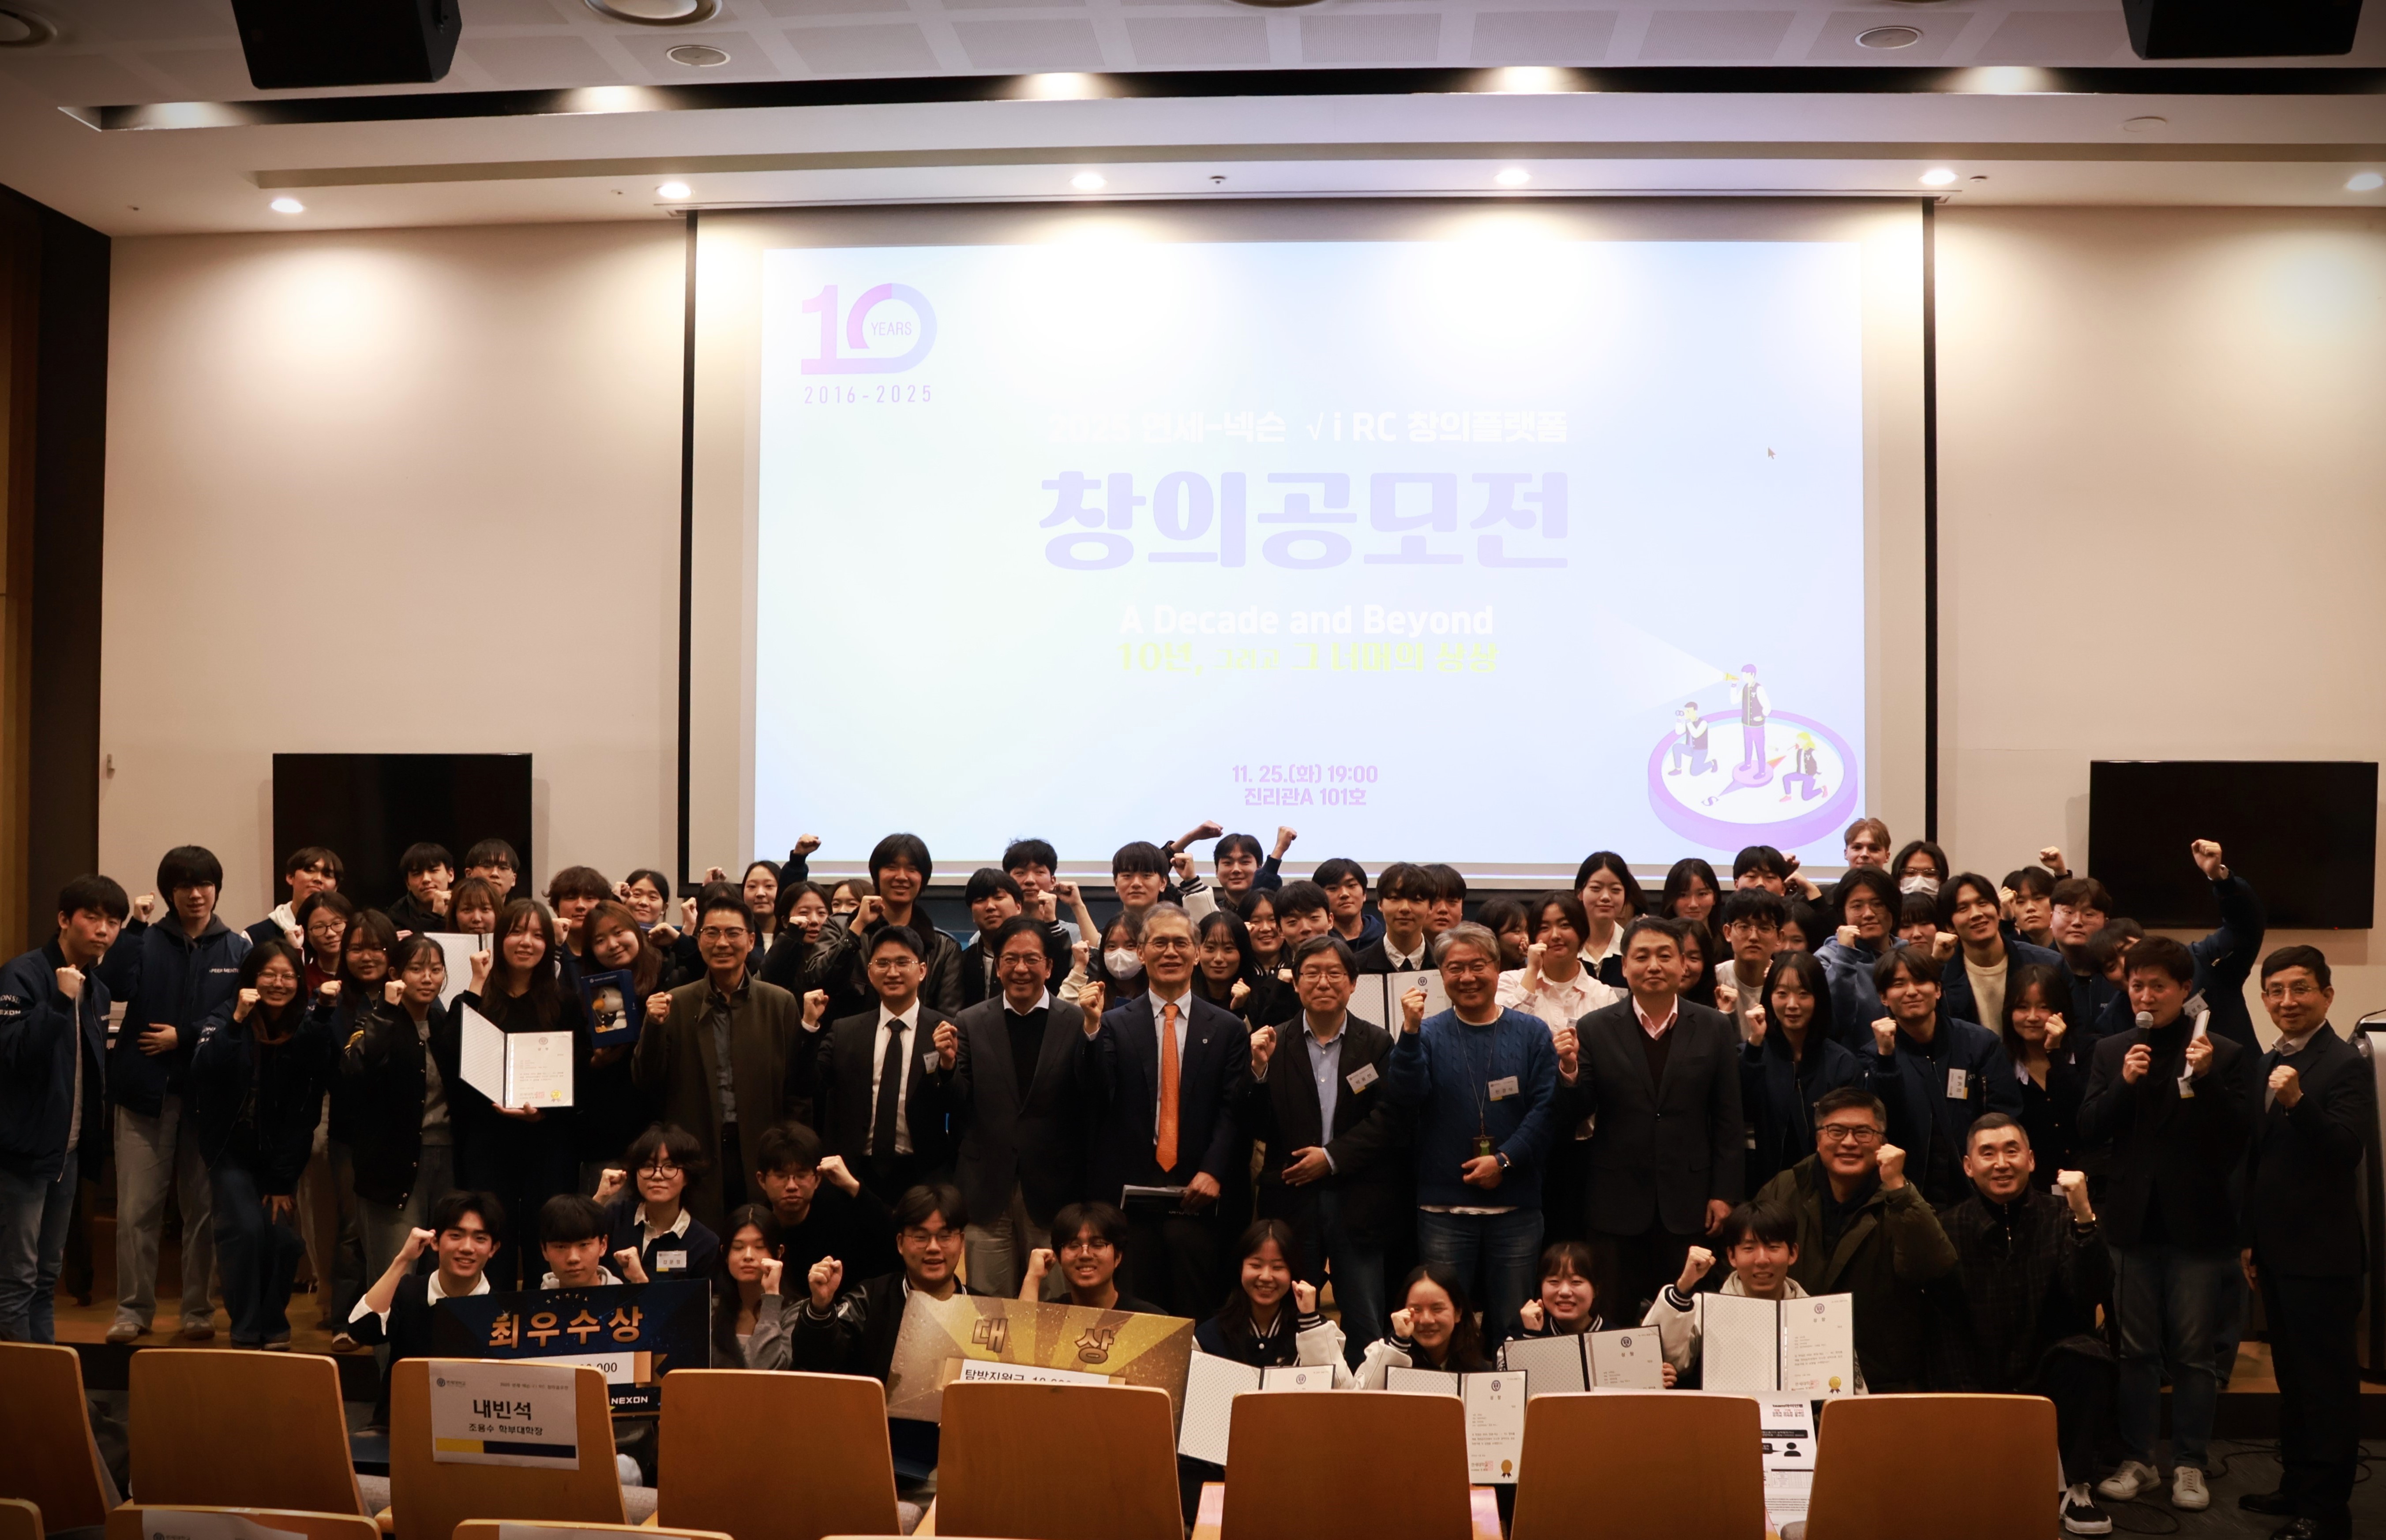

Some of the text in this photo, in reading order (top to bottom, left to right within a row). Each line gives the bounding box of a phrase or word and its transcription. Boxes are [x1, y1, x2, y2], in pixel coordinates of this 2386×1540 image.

[870, 322, 912, 336] YEARS
[804, 385, 931, 404] 2016-2025
[1353, 411, 1397, 442] RC
[1407, 410, 1568, 442] 창의플랫폼
[1039, 471, 1568, 571] 창의공모전
[1119, 604, 1493, 638] A Decade and Beyond
[1116, 641, 1500, 677] 10년, 그리고 그 너머의 상상
[1232, 764, 1378, 783] 11. 25.(화) 19:00
[1245, 787, 1366, 806] 진리관A 101호
[489, 1305, 643, 1349] 최우수상
[473, 1399, 532, 1420] 내빈석
[611, 1396, 648, 1405] NEXON
[469, 1423, 543, 1435] 조용수 학부대학장
